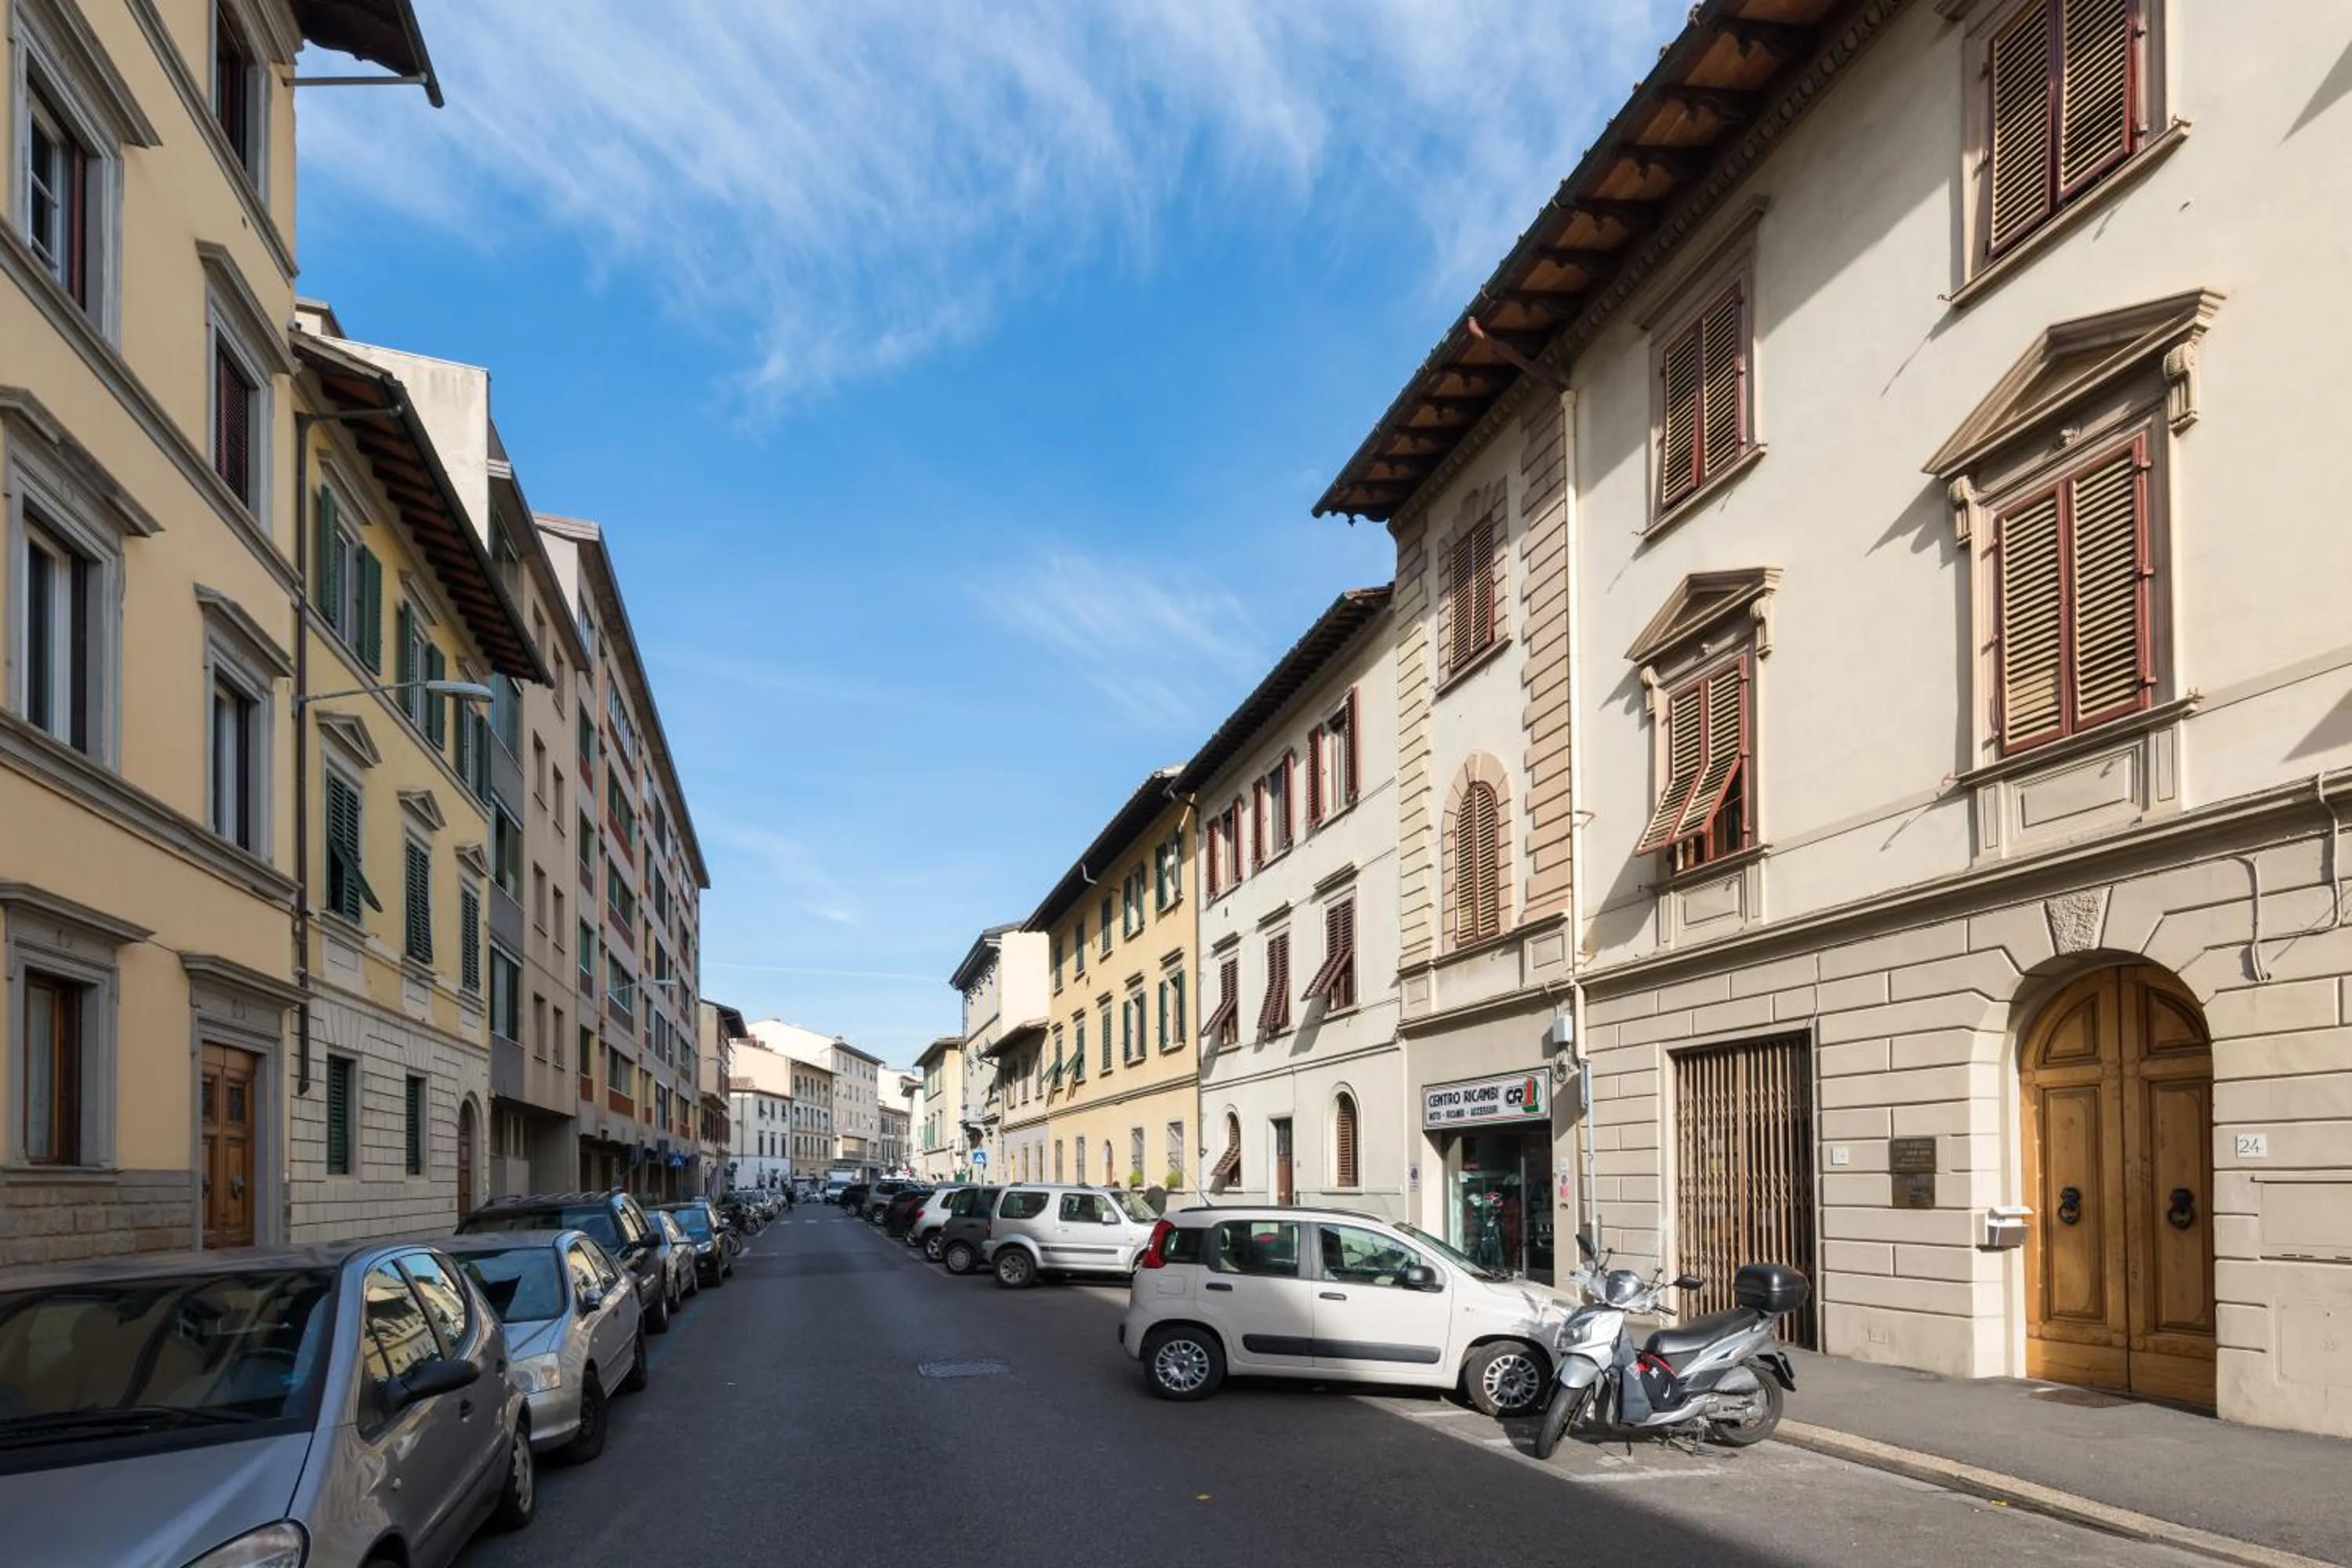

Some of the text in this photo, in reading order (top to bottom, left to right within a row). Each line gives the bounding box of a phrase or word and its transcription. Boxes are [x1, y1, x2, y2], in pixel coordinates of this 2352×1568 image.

[1428, 1086, 1499, 1107] CENTRO RICAMBI
[2238, 1138, 2265, 1153] 24
